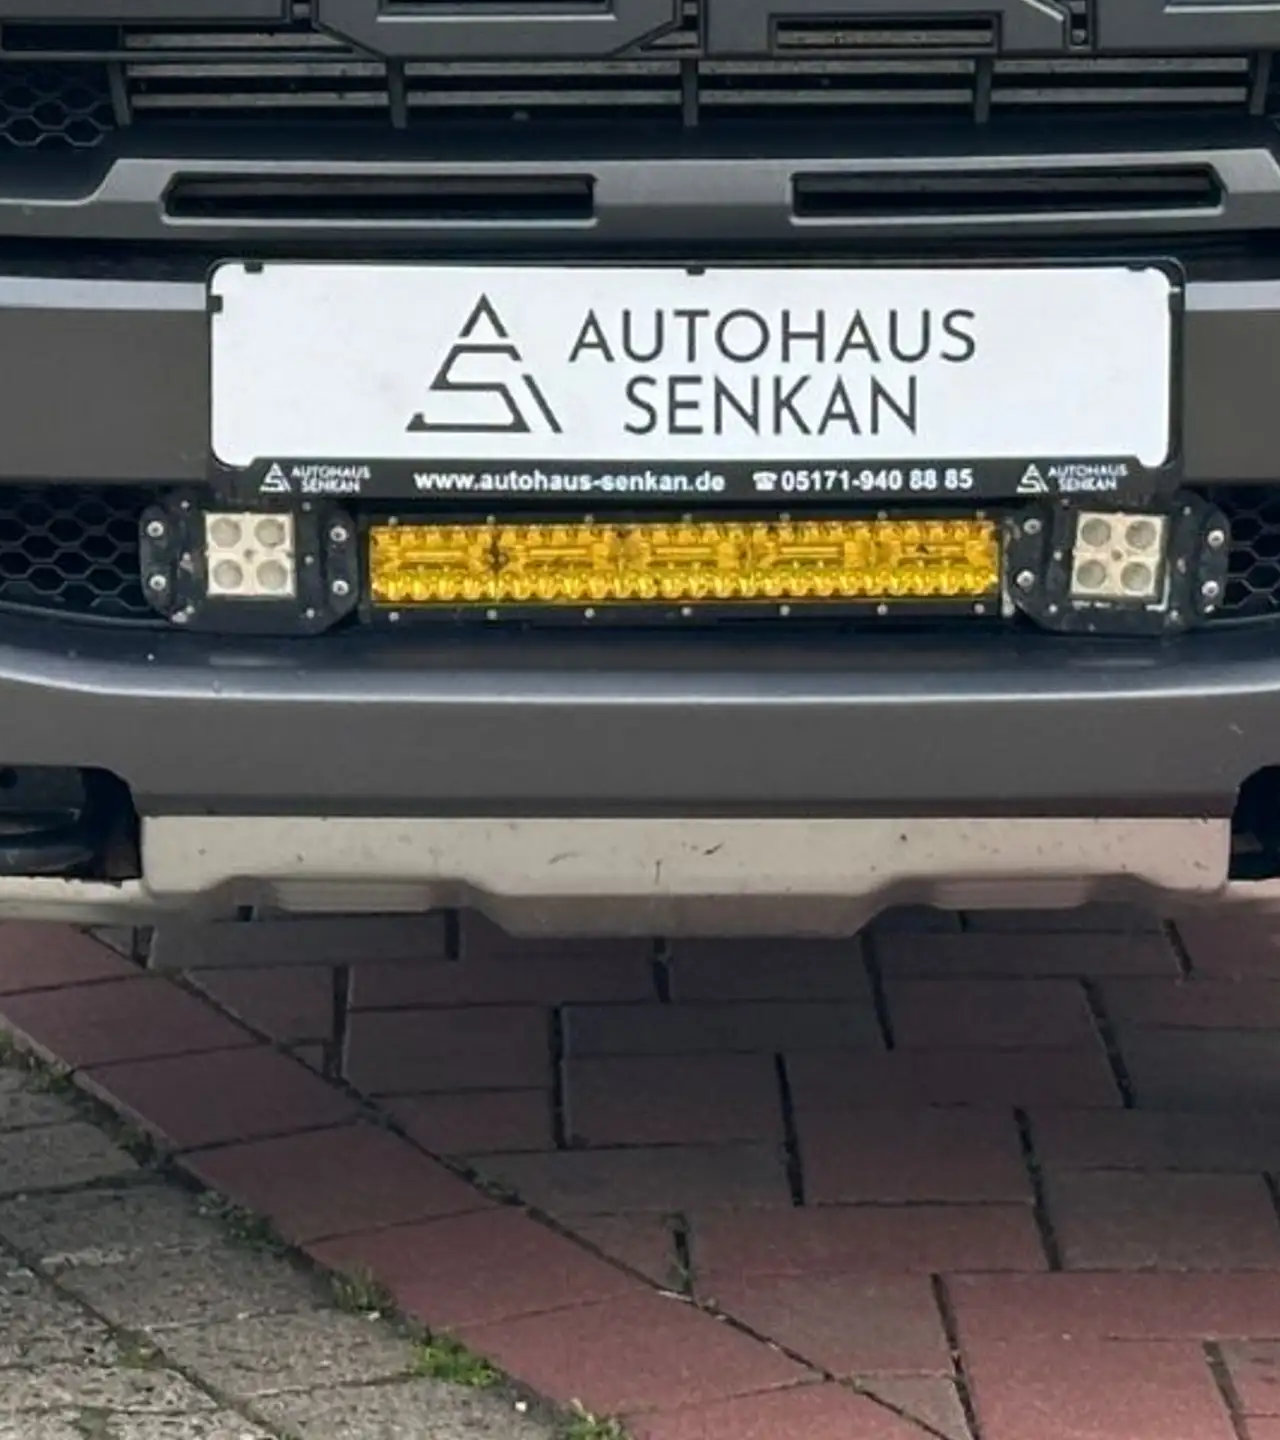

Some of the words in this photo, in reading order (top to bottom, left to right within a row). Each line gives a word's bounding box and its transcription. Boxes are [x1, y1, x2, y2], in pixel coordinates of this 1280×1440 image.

[568, 308, 977, 364] AUTOHAUS
[623, 373, 919, 436] SENKAN
[291, 465, 372, 480] AUTOHAUS
[780, 469, 903, 491] 05171-940
[908, 468, 938, 490] 88
[944, 467, 974, 490] 85
[1047, 463, 1129, 478] AUTOHAUS
[301, 478, 362, 493] SENKAN
[412, 469, 726, 492] www.autohaus-senkan.de
[1057, 477, 1118, 492] SENKAN
